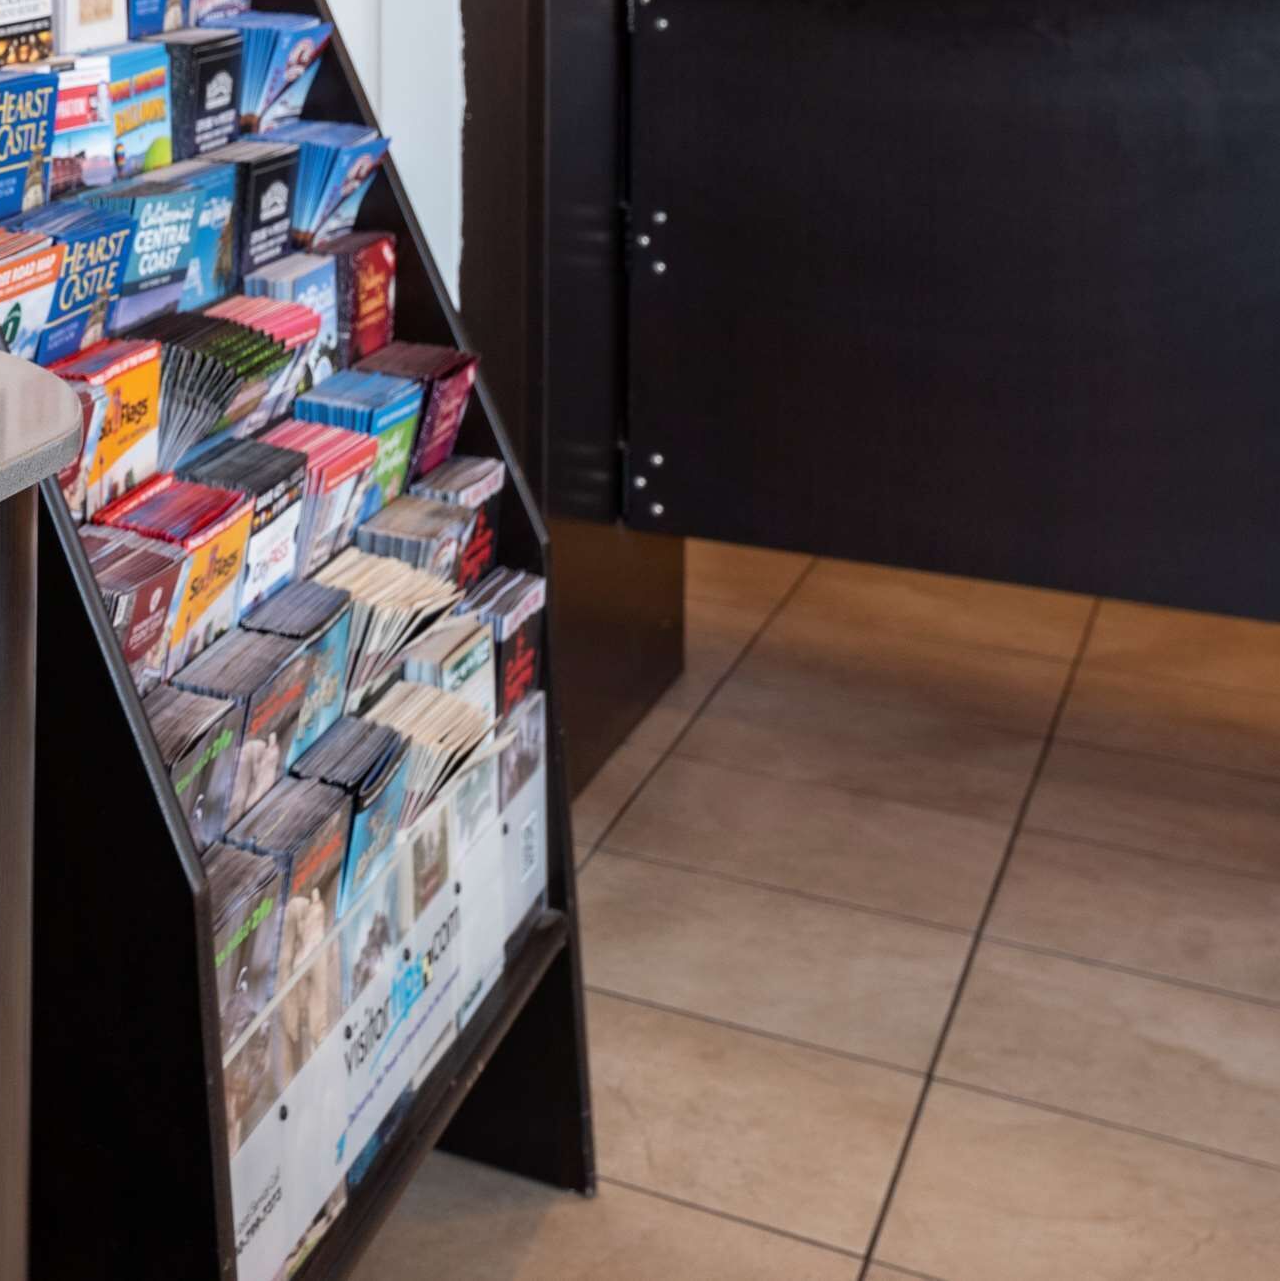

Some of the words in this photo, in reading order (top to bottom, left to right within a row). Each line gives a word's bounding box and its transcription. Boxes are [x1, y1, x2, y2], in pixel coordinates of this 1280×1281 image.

[60, 229, 131, 278] HEARST
[134, 222, 192, 254] CENTRAL
[138, 245, 182, 276] COAST
[59, 261, 120, 311] CASTLE
